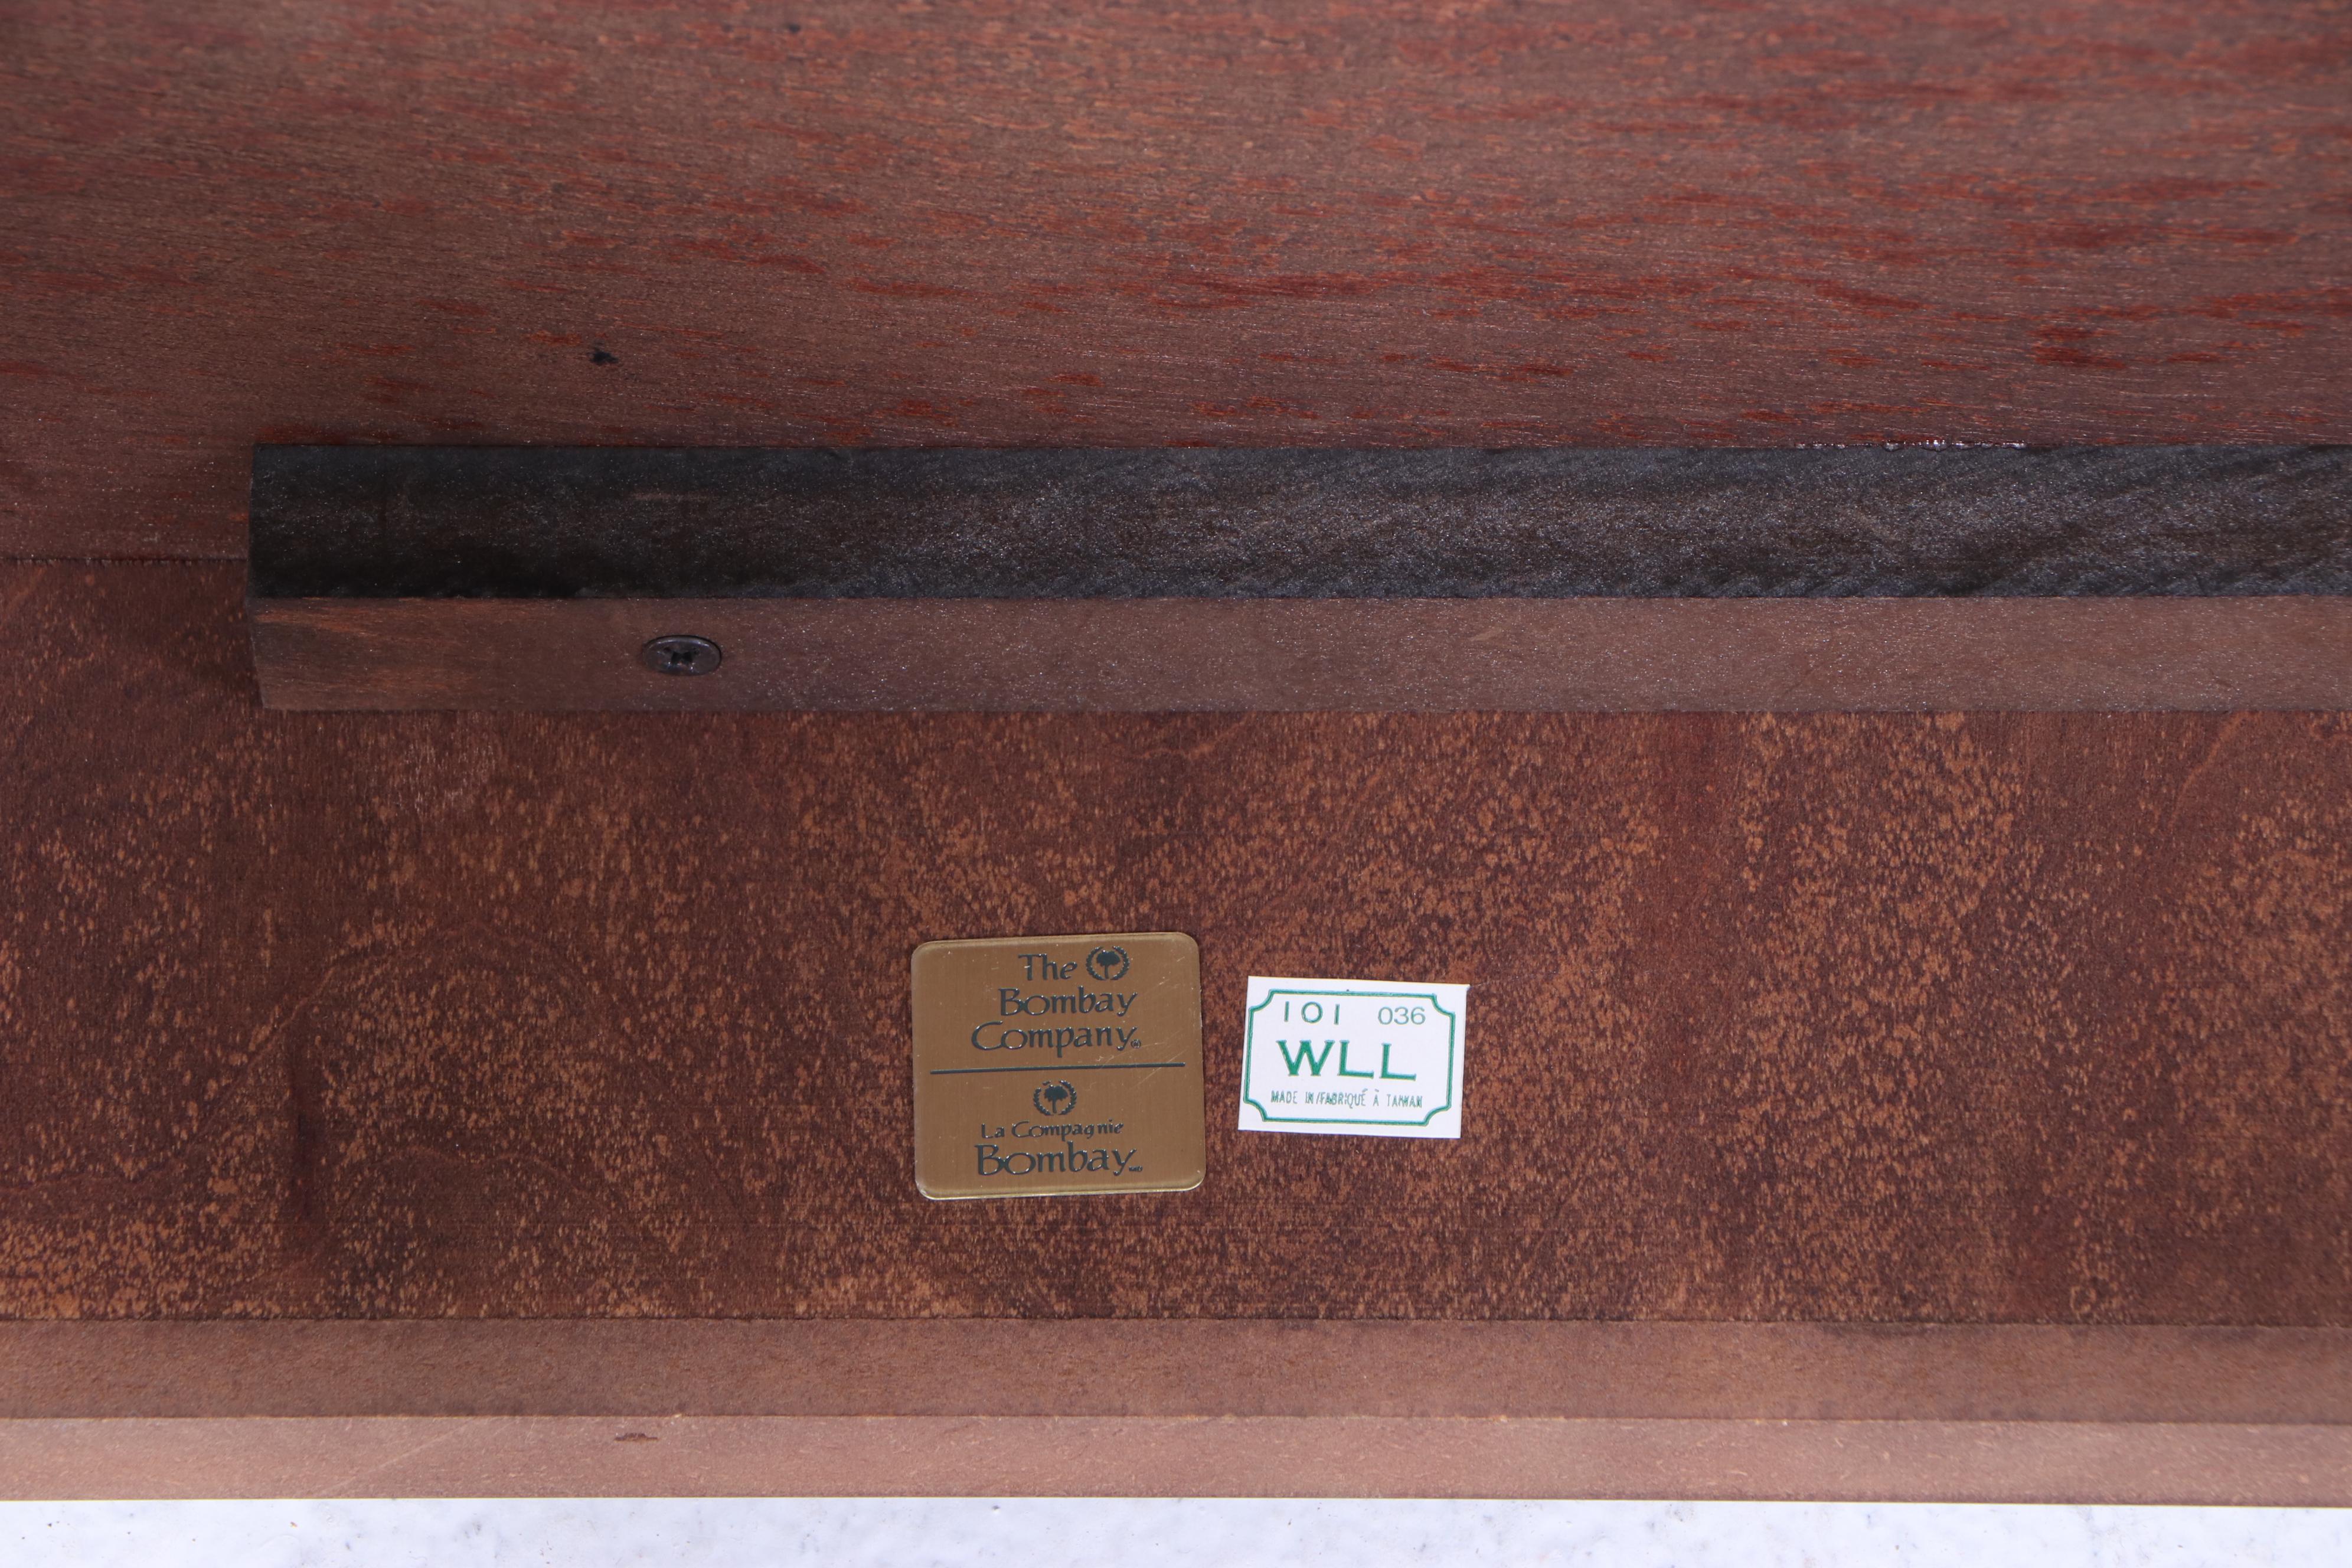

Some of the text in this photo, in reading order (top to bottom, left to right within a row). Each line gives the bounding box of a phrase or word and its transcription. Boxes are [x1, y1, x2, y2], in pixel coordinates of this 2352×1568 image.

[1018, 953, 1078, 981] The
[998, 985, 1138, 1016] Bombay
[1284, 1001, 1426, 1025] 101 036
[1276, 1039, 1417, 1081] WLL
[1270, 1090, 1298, 1103] MADE
[1373, 1088, 1379, 1107] À
[1387, 1094, 1422, 1108] TAIWAN
[981, 1119, 1124, 1141] La Compagnie
